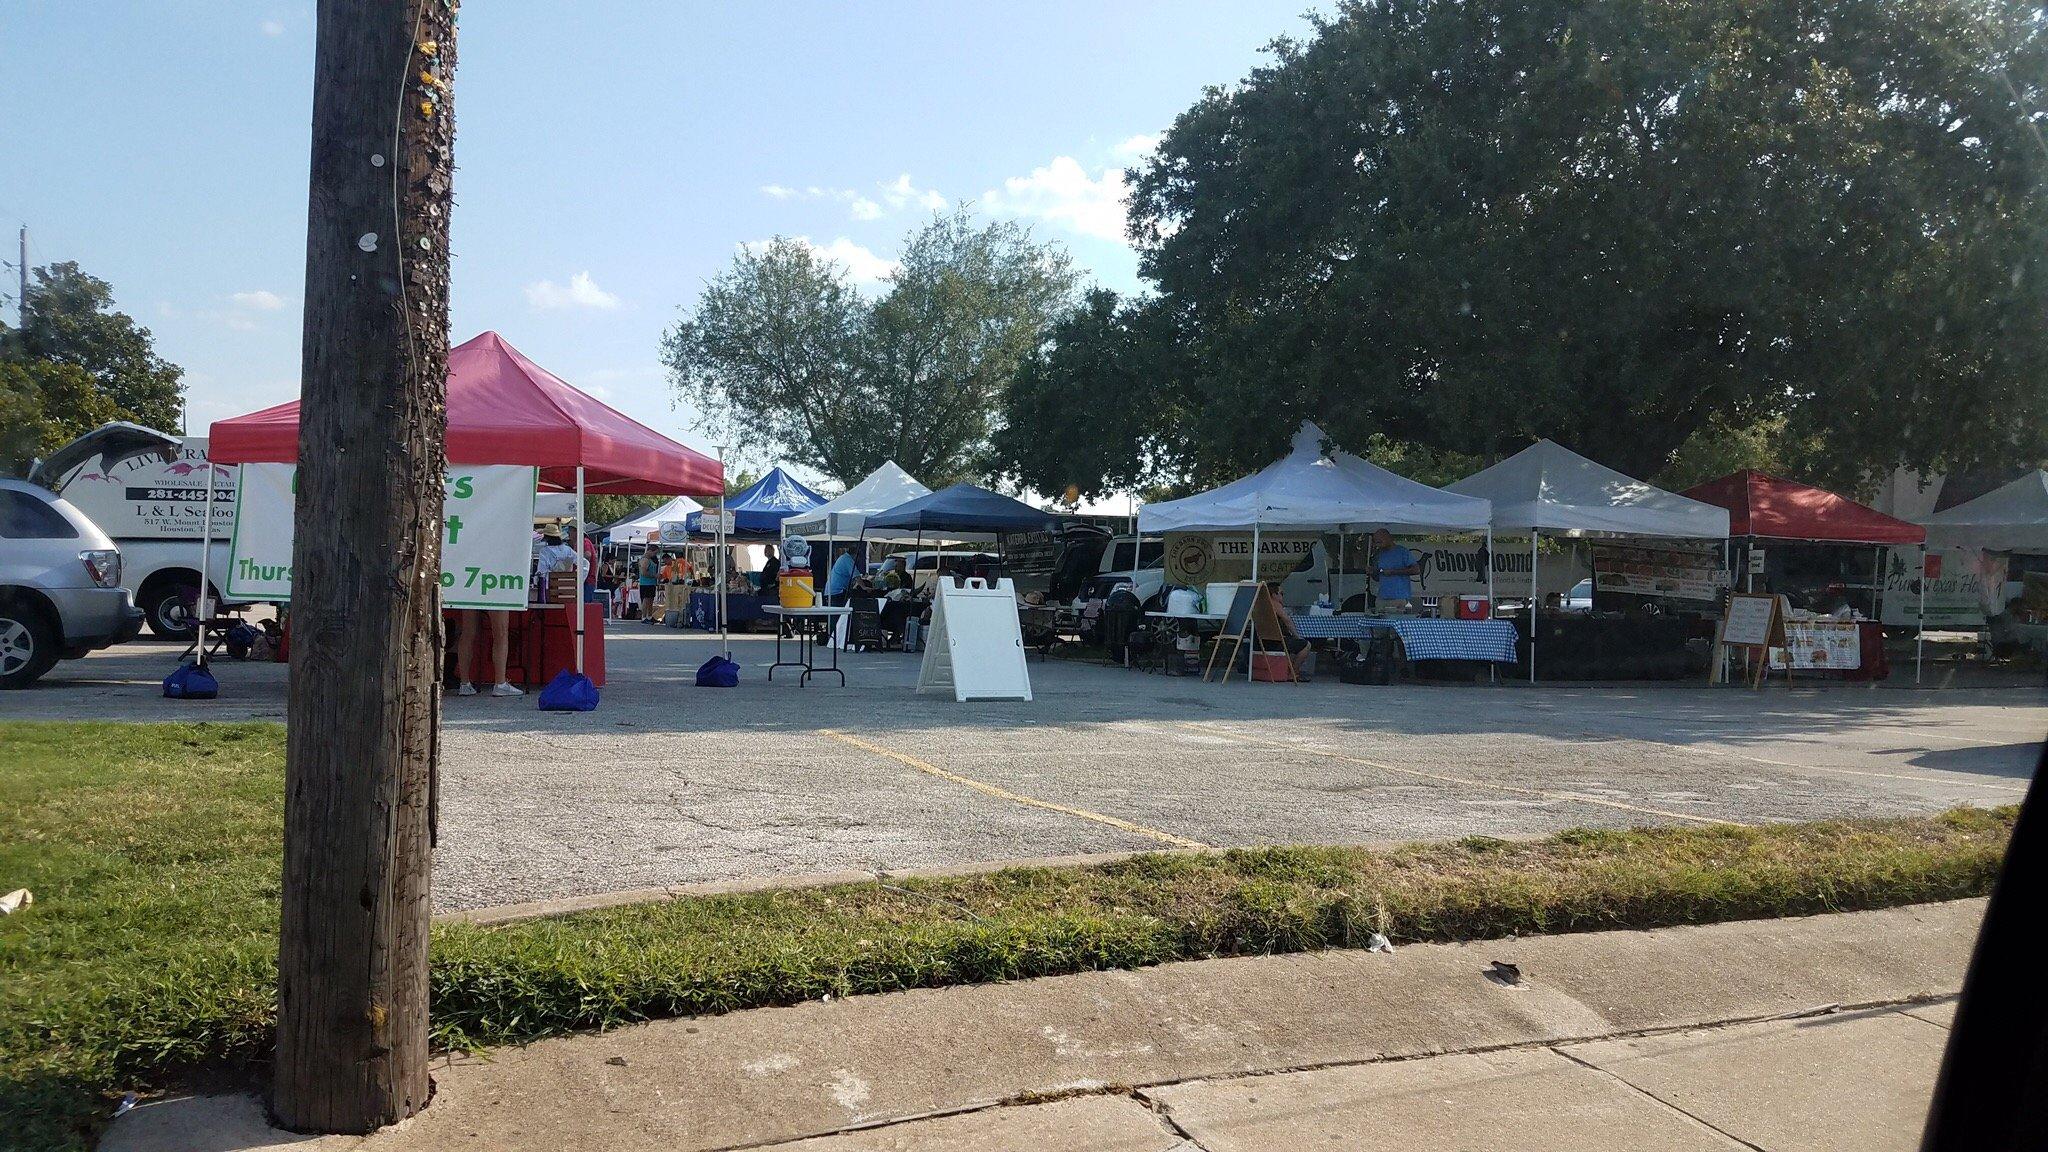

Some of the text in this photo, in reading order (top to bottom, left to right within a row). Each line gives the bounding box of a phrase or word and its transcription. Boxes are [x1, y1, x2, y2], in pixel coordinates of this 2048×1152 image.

[155, 480, 203, 488] WHOLESALE
[137, 505, 148, 517] L
[152, 505, 165, 517] &
[169, 505, 180, 517] L
[144, 518, 160, 526] 517
[174, 519, 201, 527] Mount
[1218, 541, 1248, 554] THE
[464, 566, 524, 596] 7pm
